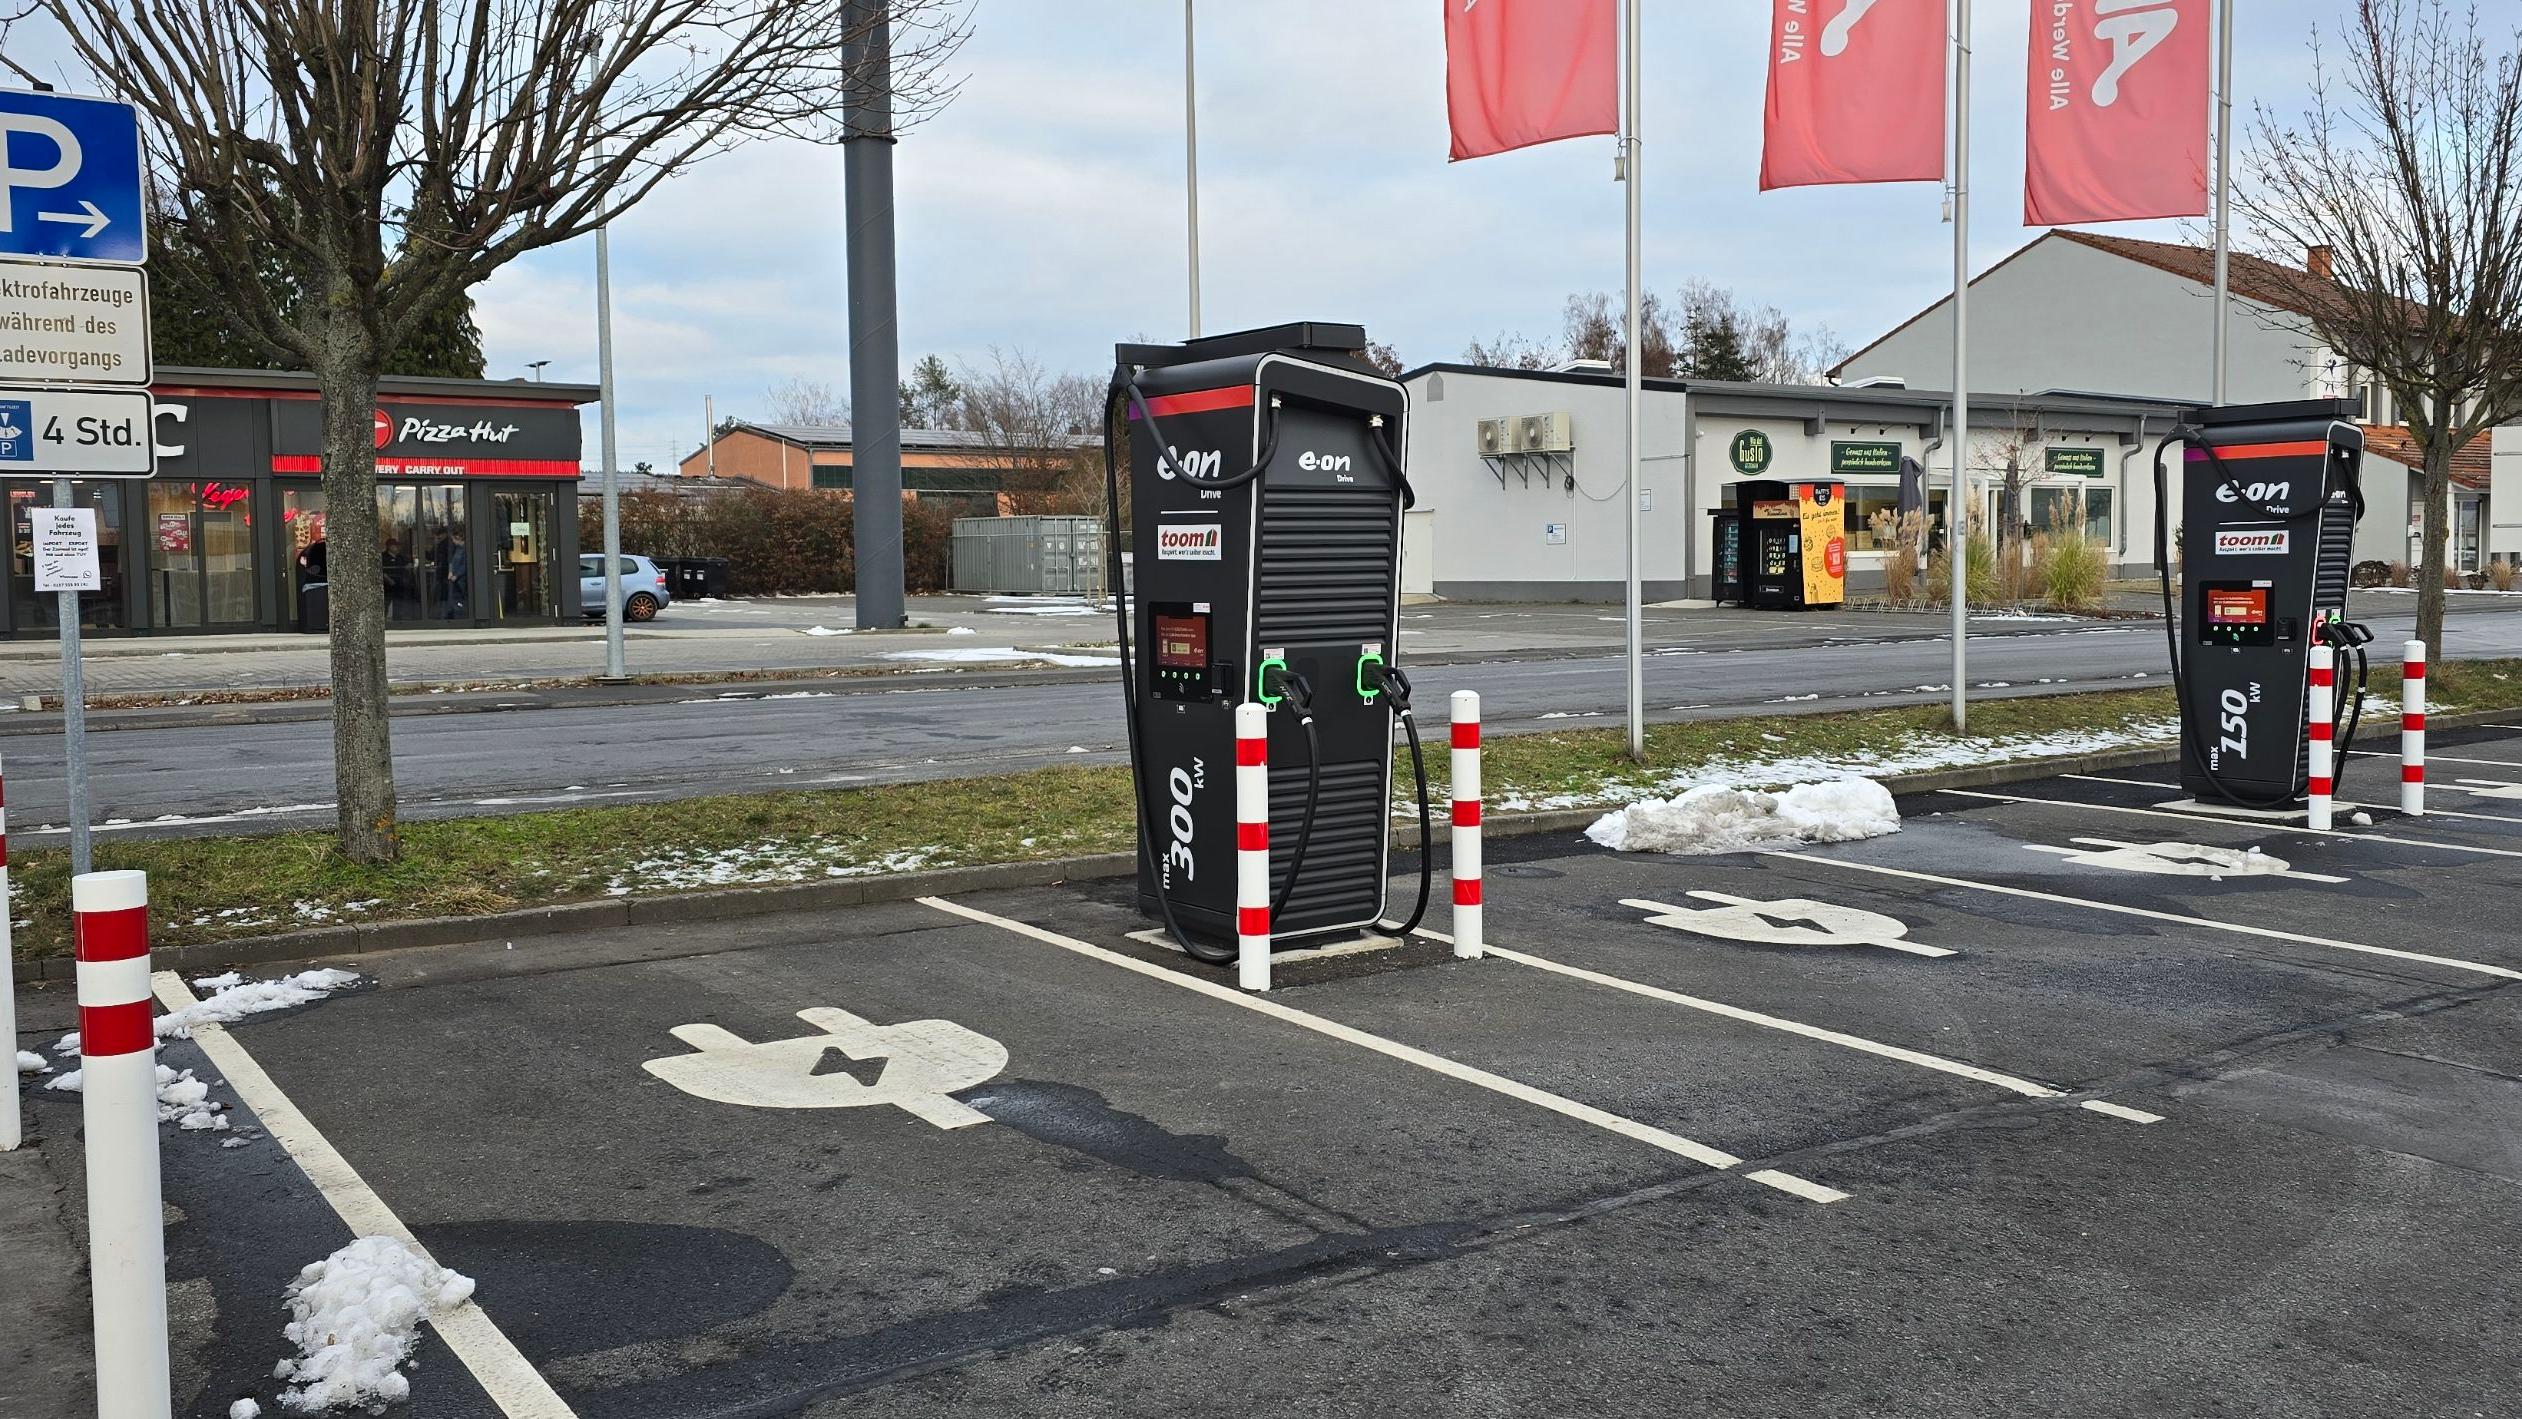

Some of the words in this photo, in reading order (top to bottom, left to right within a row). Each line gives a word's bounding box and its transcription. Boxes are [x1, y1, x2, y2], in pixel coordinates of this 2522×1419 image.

[0, 113, 82, 233] P
[0, 278, 133, 308] ktrofahrzeuge
[85, 316, 117, 334] des
[0, 345, 122, 370] adevorgangs
[42, 415, 64, 445] 4
[76, 416, 141, 446] Std.
[398, 417, 467, 443] Pizza
[468, 420, 520, 443] Hut
[405, 465, 442, 475] CARRY
[443, 466, 465, 475] OUT
[1161, 528, 1205, 547] toom
[2218, 534, 2269, 547] toom
[2249, 681, 2261, 702] kW
[2220, 688, 2248, 760] 150
[2210, 746, 2218, 771] max
[1193, 756, 1204, 789] kW
[1169, 766, 1194, 881] 300
[1163, 852, 1171, 890] max
